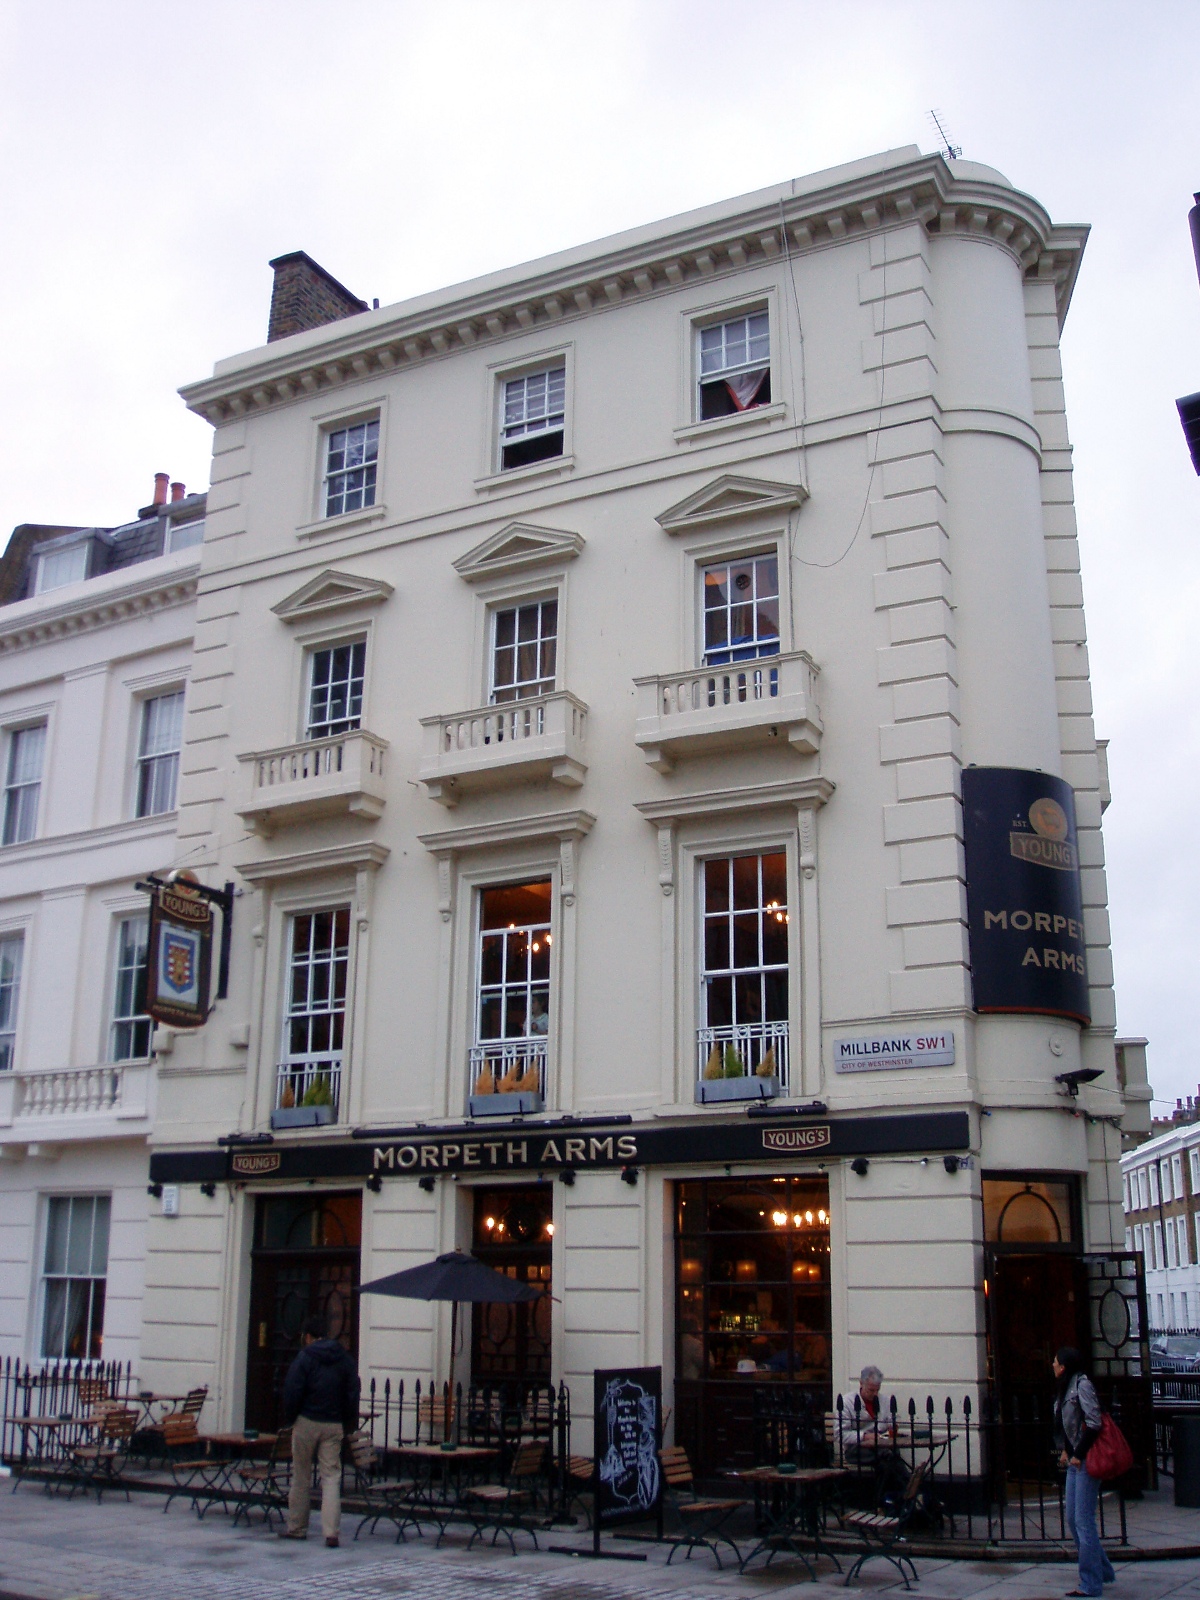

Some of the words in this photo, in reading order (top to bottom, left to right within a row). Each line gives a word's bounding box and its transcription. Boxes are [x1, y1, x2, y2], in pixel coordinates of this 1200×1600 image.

[1018, 838, 1076, 866] YOUNG
[984, 910, 1085, 941] MORPET
[1021, 946, 1085, 976] ARMS
[840, 1039, 912, 1056] MILLBANK
[916, 1036, 946, 1050] SW1
[841, 1062, 856, 1070] CITY
[857, 1061, 867, 1069] OF
[868, 1058, 913, 1069] WESTMINSTER
[767, 1129, 825, 1146] YOUNG'S
[373, 1141, 528, 1169] MORPETH
[540, 1135, 638, 1162] ARMS
